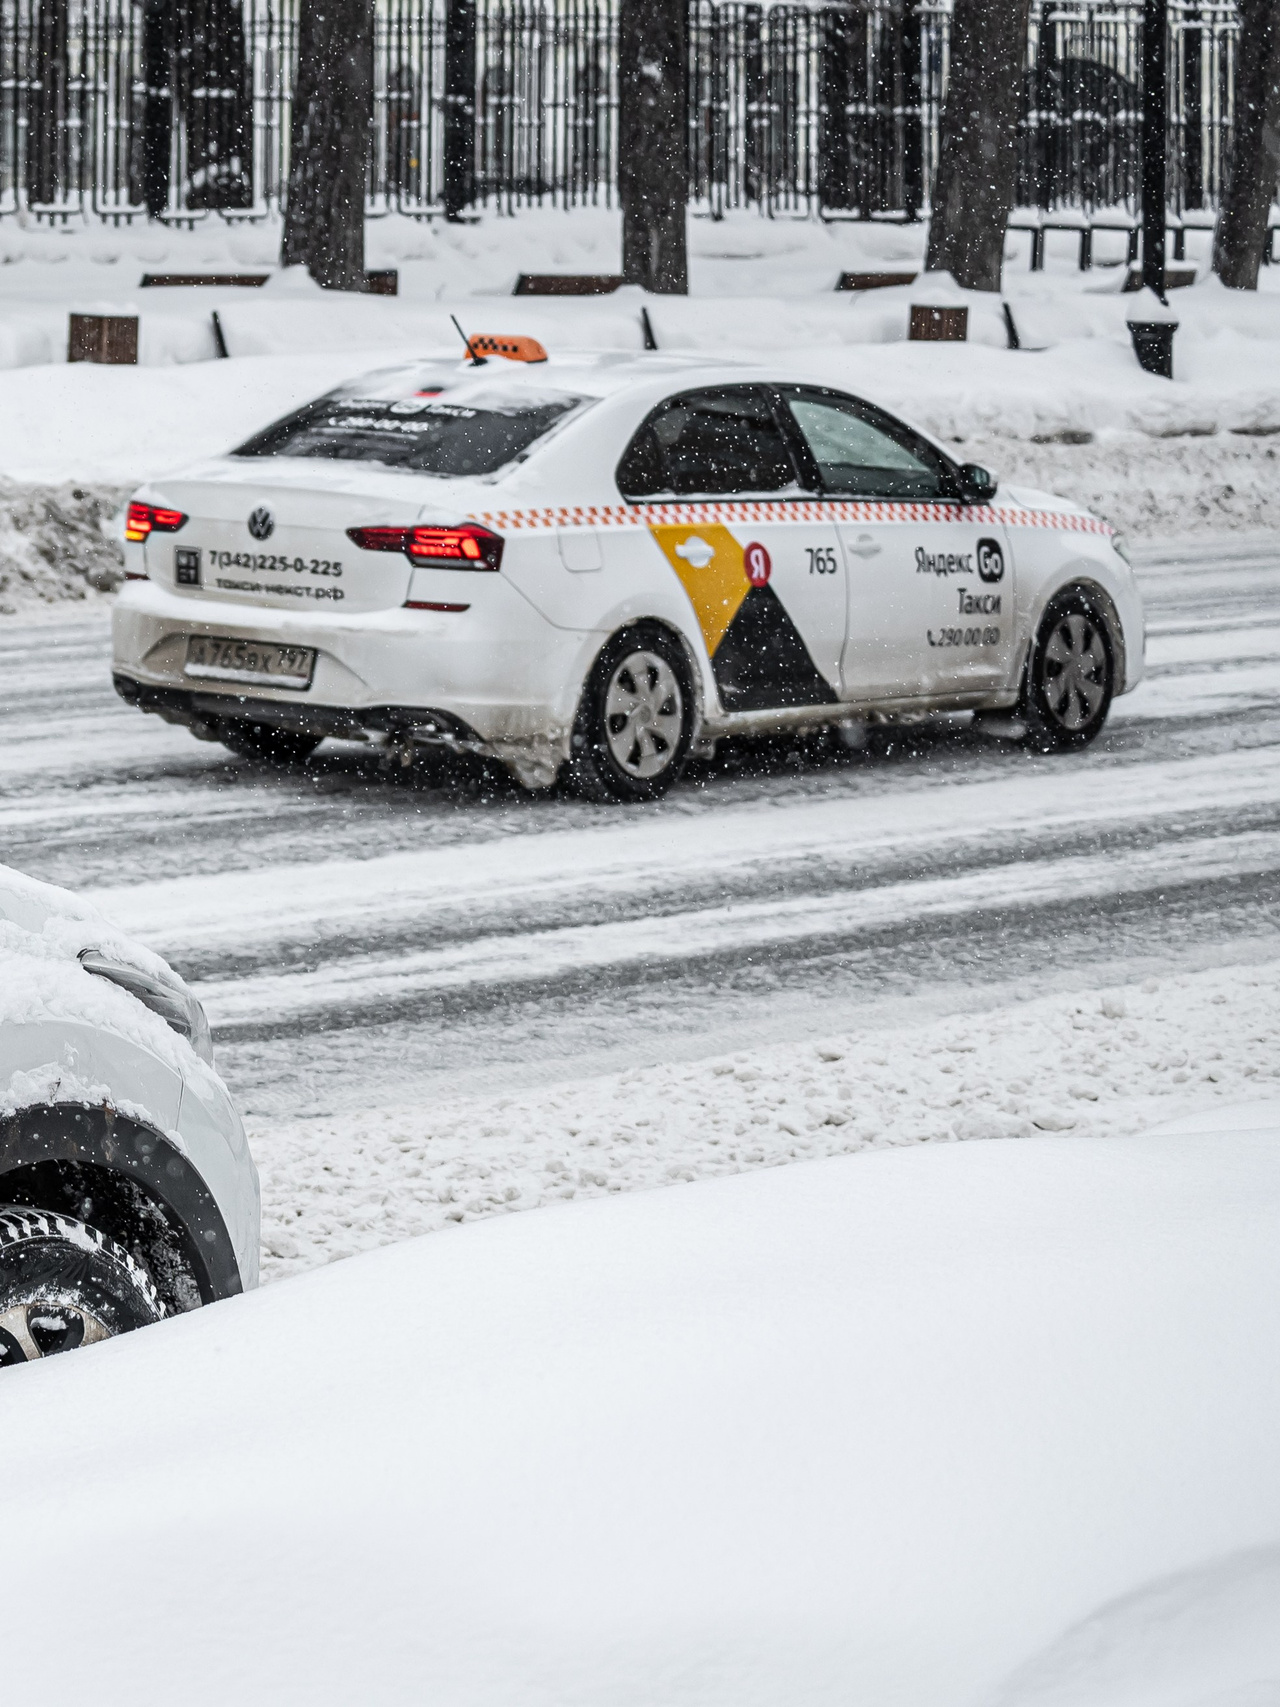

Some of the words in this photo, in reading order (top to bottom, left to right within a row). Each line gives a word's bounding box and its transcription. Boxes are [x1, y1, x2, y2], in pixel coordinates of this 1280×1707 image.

[750, 548, 766, 579] Я
[805, 547, 837, 574] 765
[915, 546, 973, 577] Яндекс
[979, 545, 1001, 575] Go
[957, 588, 1001, 614] Такси
